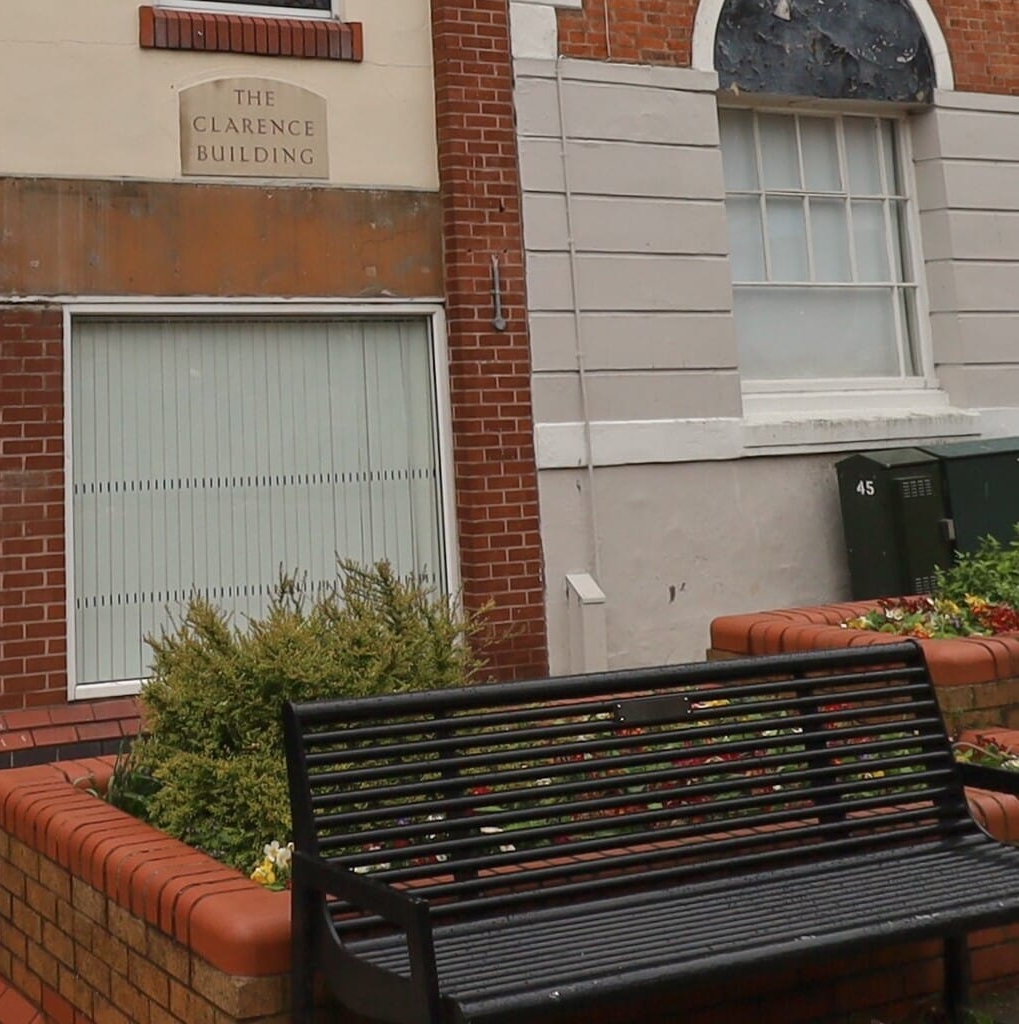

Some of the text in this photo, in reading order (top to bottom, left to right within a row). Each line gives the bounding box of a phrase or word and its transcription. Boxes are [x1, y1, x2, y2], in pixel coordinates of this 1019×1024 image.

[233, 89, 275, 107] THE
[193, 116, 315, 137] CLARENCE
[197, 145, 314, 165] BUILDING
[856, 480, 875, 496] 45
